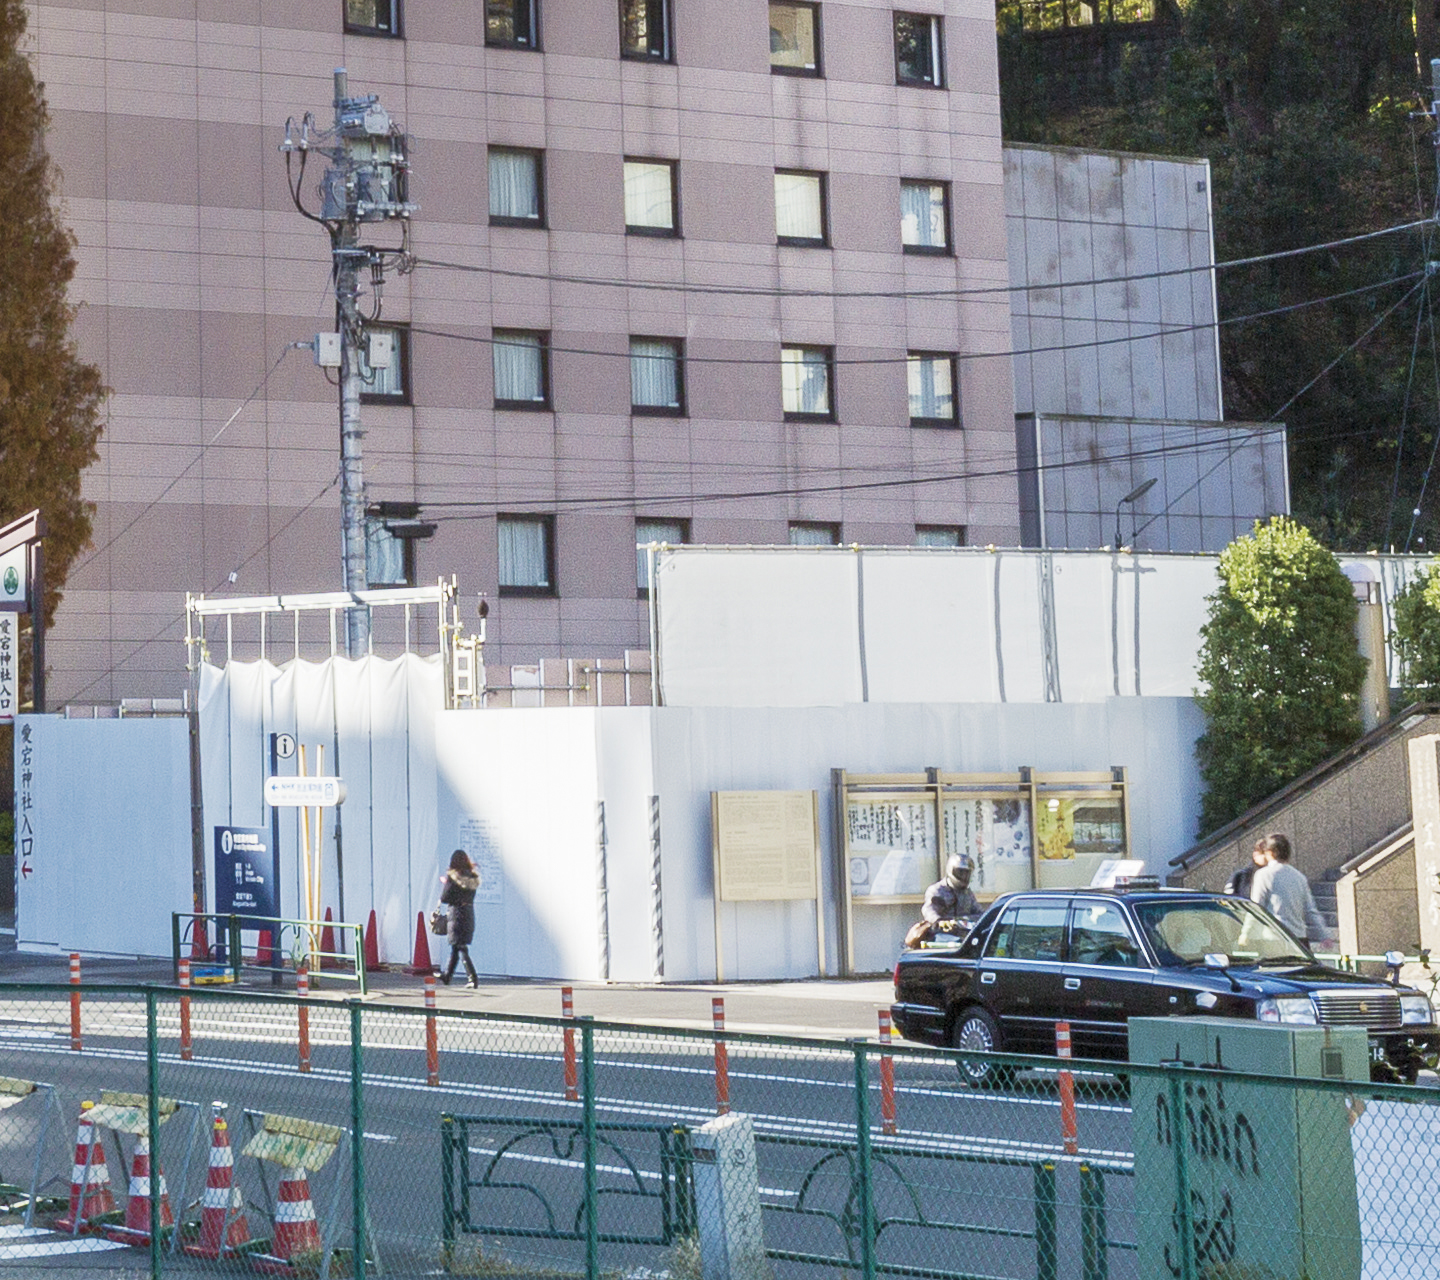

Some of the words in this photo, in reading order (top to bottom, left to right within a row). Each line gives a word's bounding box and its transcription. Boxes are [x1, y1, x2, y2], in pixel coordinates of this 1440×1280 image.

[20, 723, 34, 858] 愛宕神社入口
